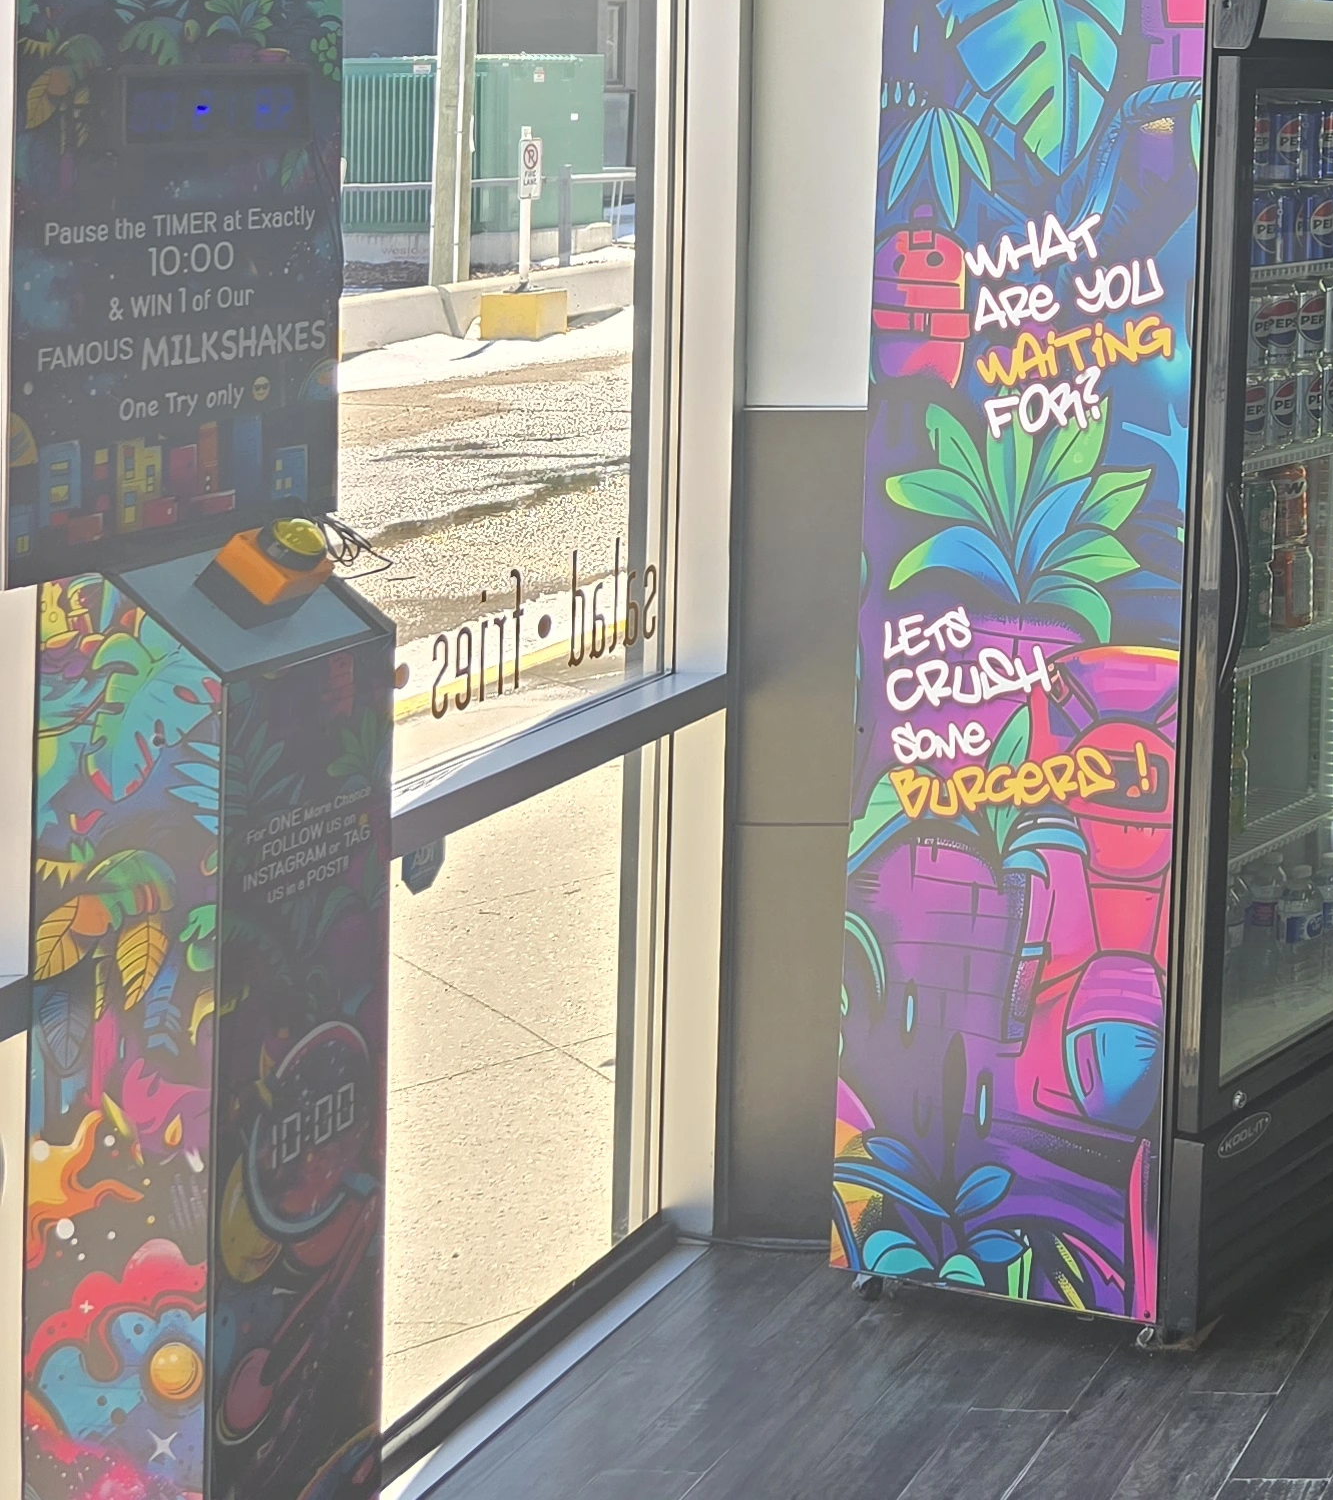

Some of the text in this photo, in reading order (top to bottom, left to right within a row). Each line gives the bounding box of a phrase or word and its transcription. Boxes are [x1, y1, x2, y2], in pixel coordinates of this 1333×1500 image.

[44, 205, 316, 246] Pause the TIMER at Exactly
[964, 212, 1103, 279] WHAT
[148, 241, 235, 277] 10:00
[1075, 257, 1166, 306] YOU
[108, 298, 124, 321] &
[131, 293, 172, 317] WIN
[192, 288, 212, 311] of
[216, 286, 255, 309] Our
[37, 320, 327, 372] FAMOUS MILKSHAKES
[119, 382, 245, 422] One Try only
[984, 367, 1104, 439] FOR?
[884, 607, 971, 660] LETS
[885, 644, 1053, 709] CRUSH
[246, 786, 372, 845] For ONE More Chance
[262, 821, 324, 861] FOLLOW
[343, 813, 356, 827] on
[243, 824, 371, 893] INSTAGRAM or TAG
[270, 1082, 357, 1171] 10:00
